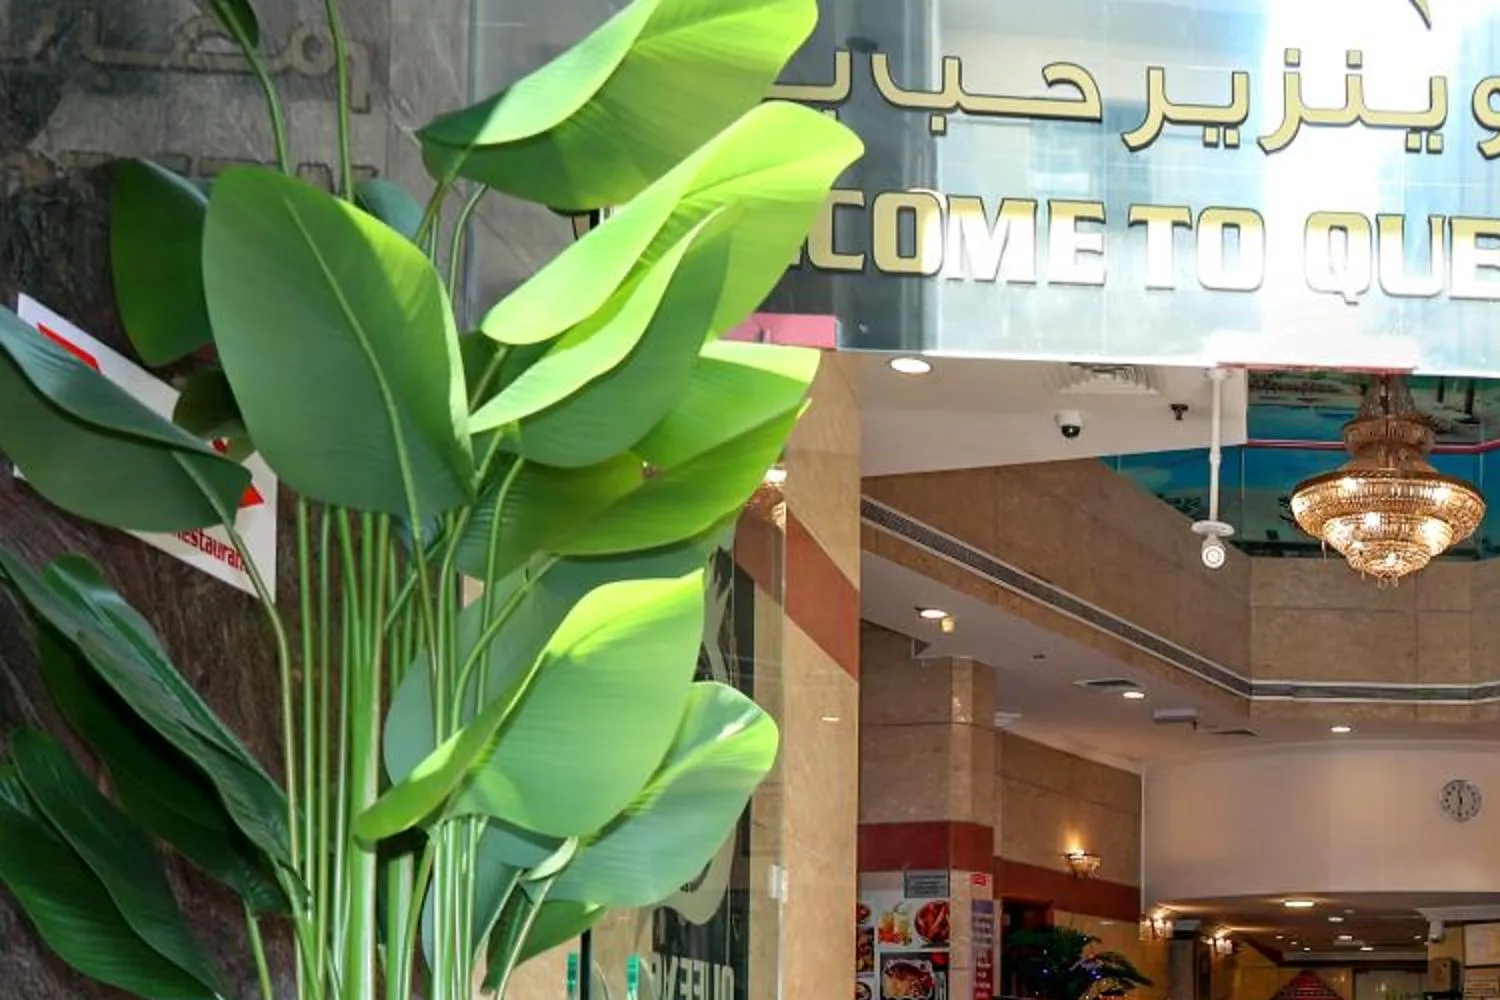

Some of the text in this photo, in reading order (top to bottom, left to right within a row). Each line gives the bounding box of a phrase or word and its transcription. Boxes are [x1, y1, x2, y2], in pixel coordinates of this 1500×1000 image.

[790, 188, 1107, 287] COME
[1128, 203, 1266, 293] TO
[174, 528, 248, 572] estauran
